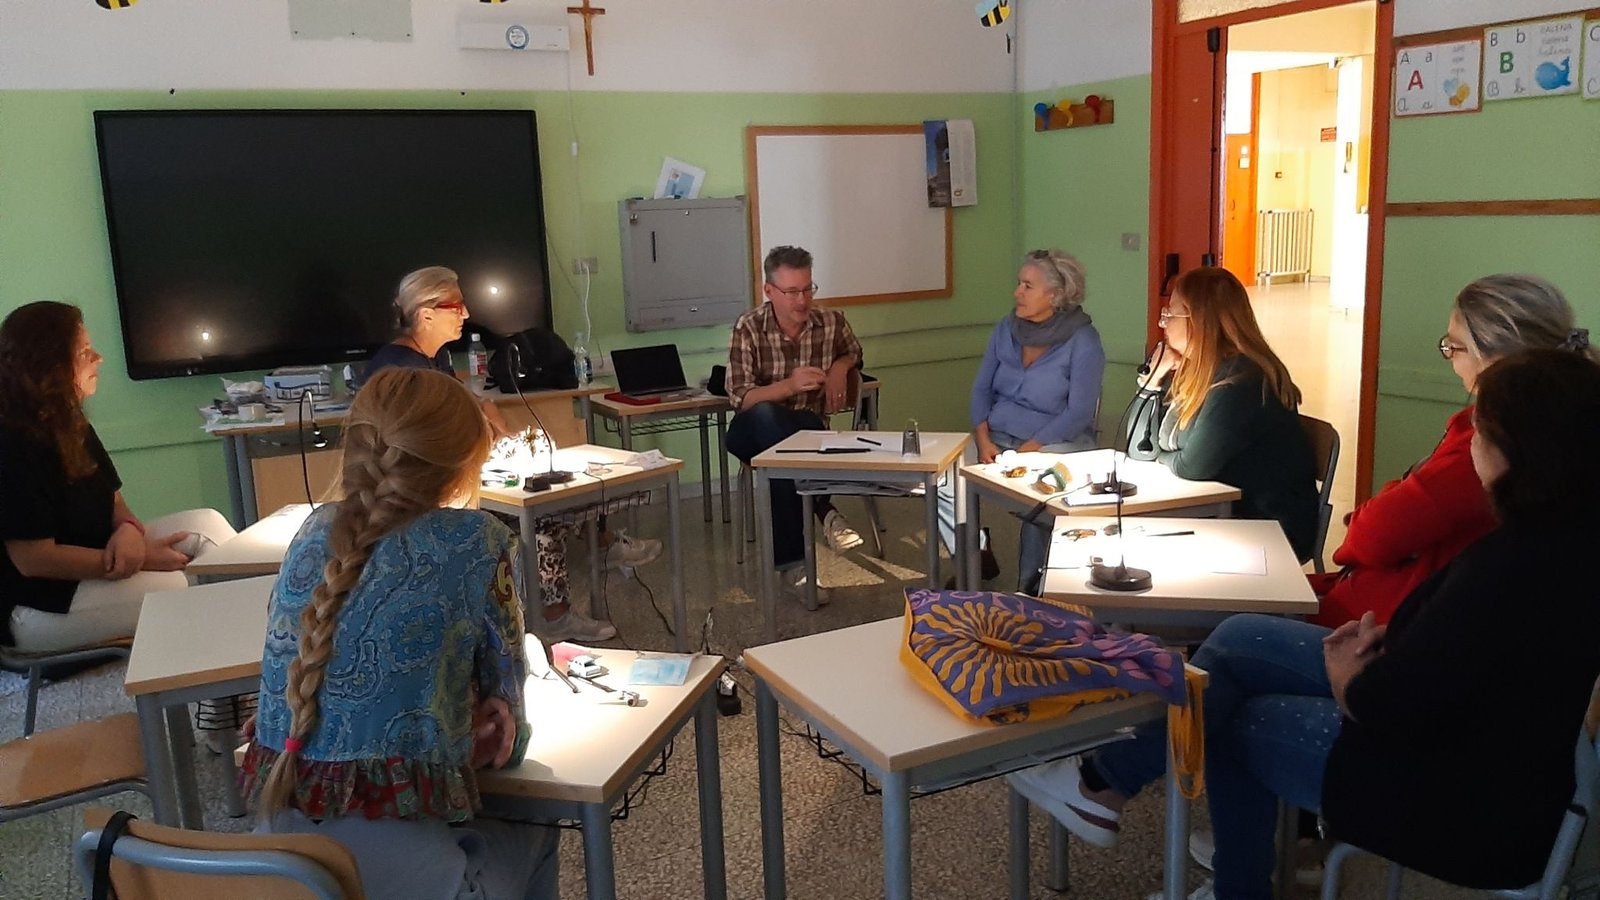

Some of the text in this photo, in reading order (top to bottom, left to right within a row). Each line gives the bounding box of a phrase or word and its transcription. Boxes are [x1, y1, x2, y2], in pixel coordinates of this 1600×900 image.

[1490, 32, 1498, 47] B
[1516, 28, 1526, 44] b
[1589, 25, 1600, 42] C
[1400, 52, 1433, 65] A a
[1500, 51, 1514, 74] B
[1407, 70, 1424, 91] A
